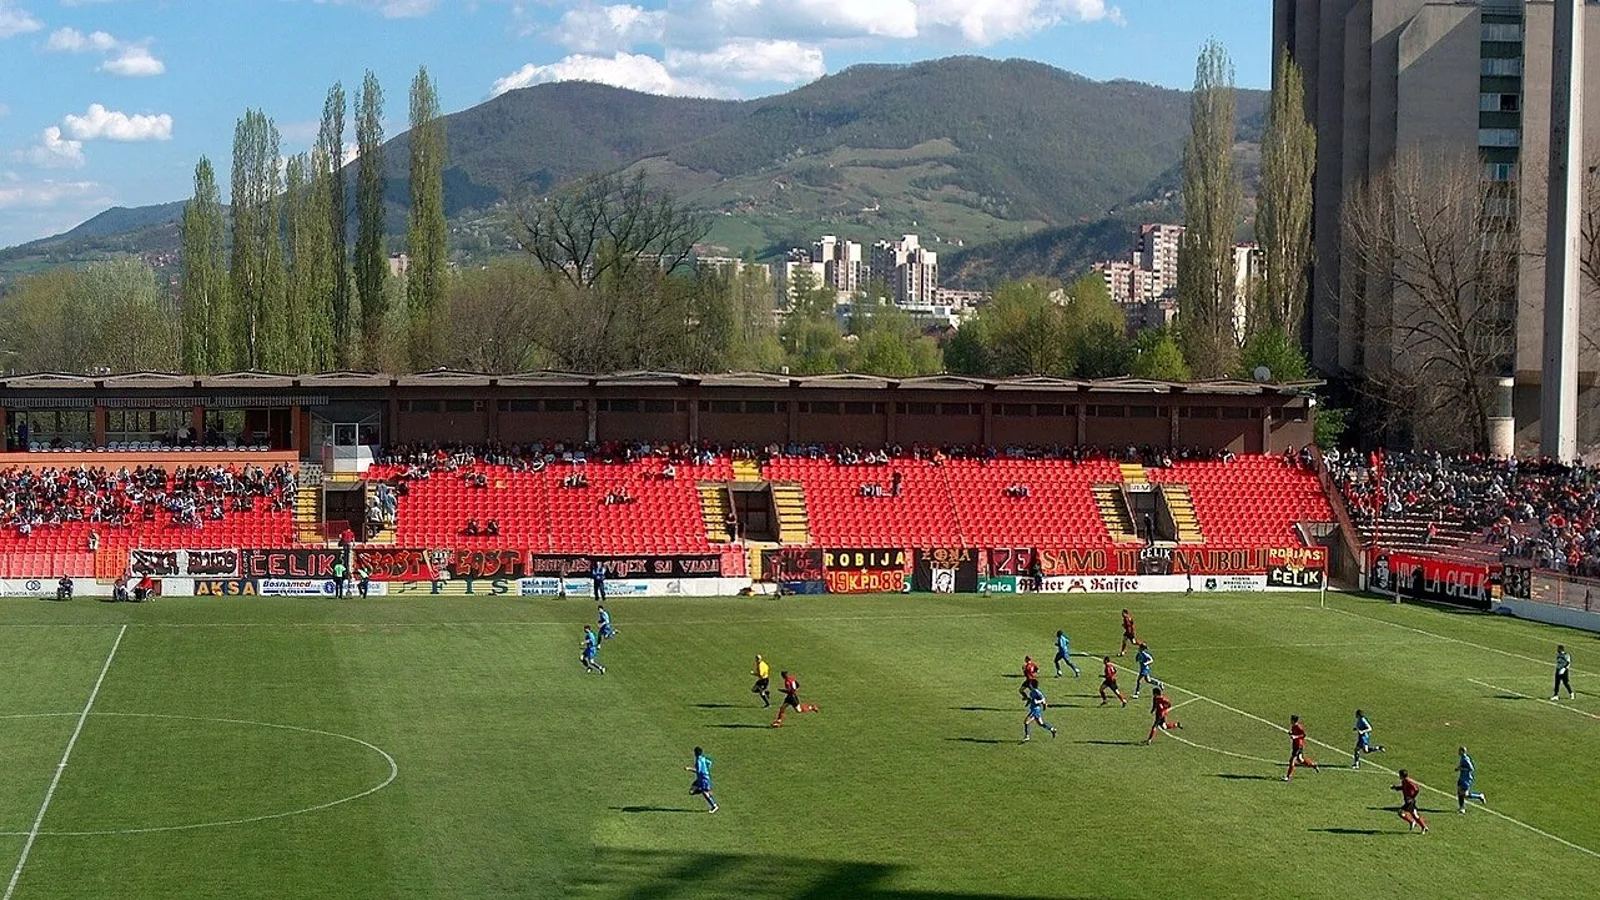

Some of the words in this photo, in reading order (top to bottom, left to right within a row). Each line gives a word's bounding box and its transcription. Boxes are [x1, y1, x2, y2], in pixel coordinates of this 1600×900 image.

[825, 552, 905, 567] ROBIJA
[1040, 548, 1107, 572] SAMO
[1173, 547, 1268, 573] NAJBOLJI
[880, 570, 904, 592] 88
[1272, 567, 1319, 586] ČELIK
[196, 580, 256, 596] AKSA
